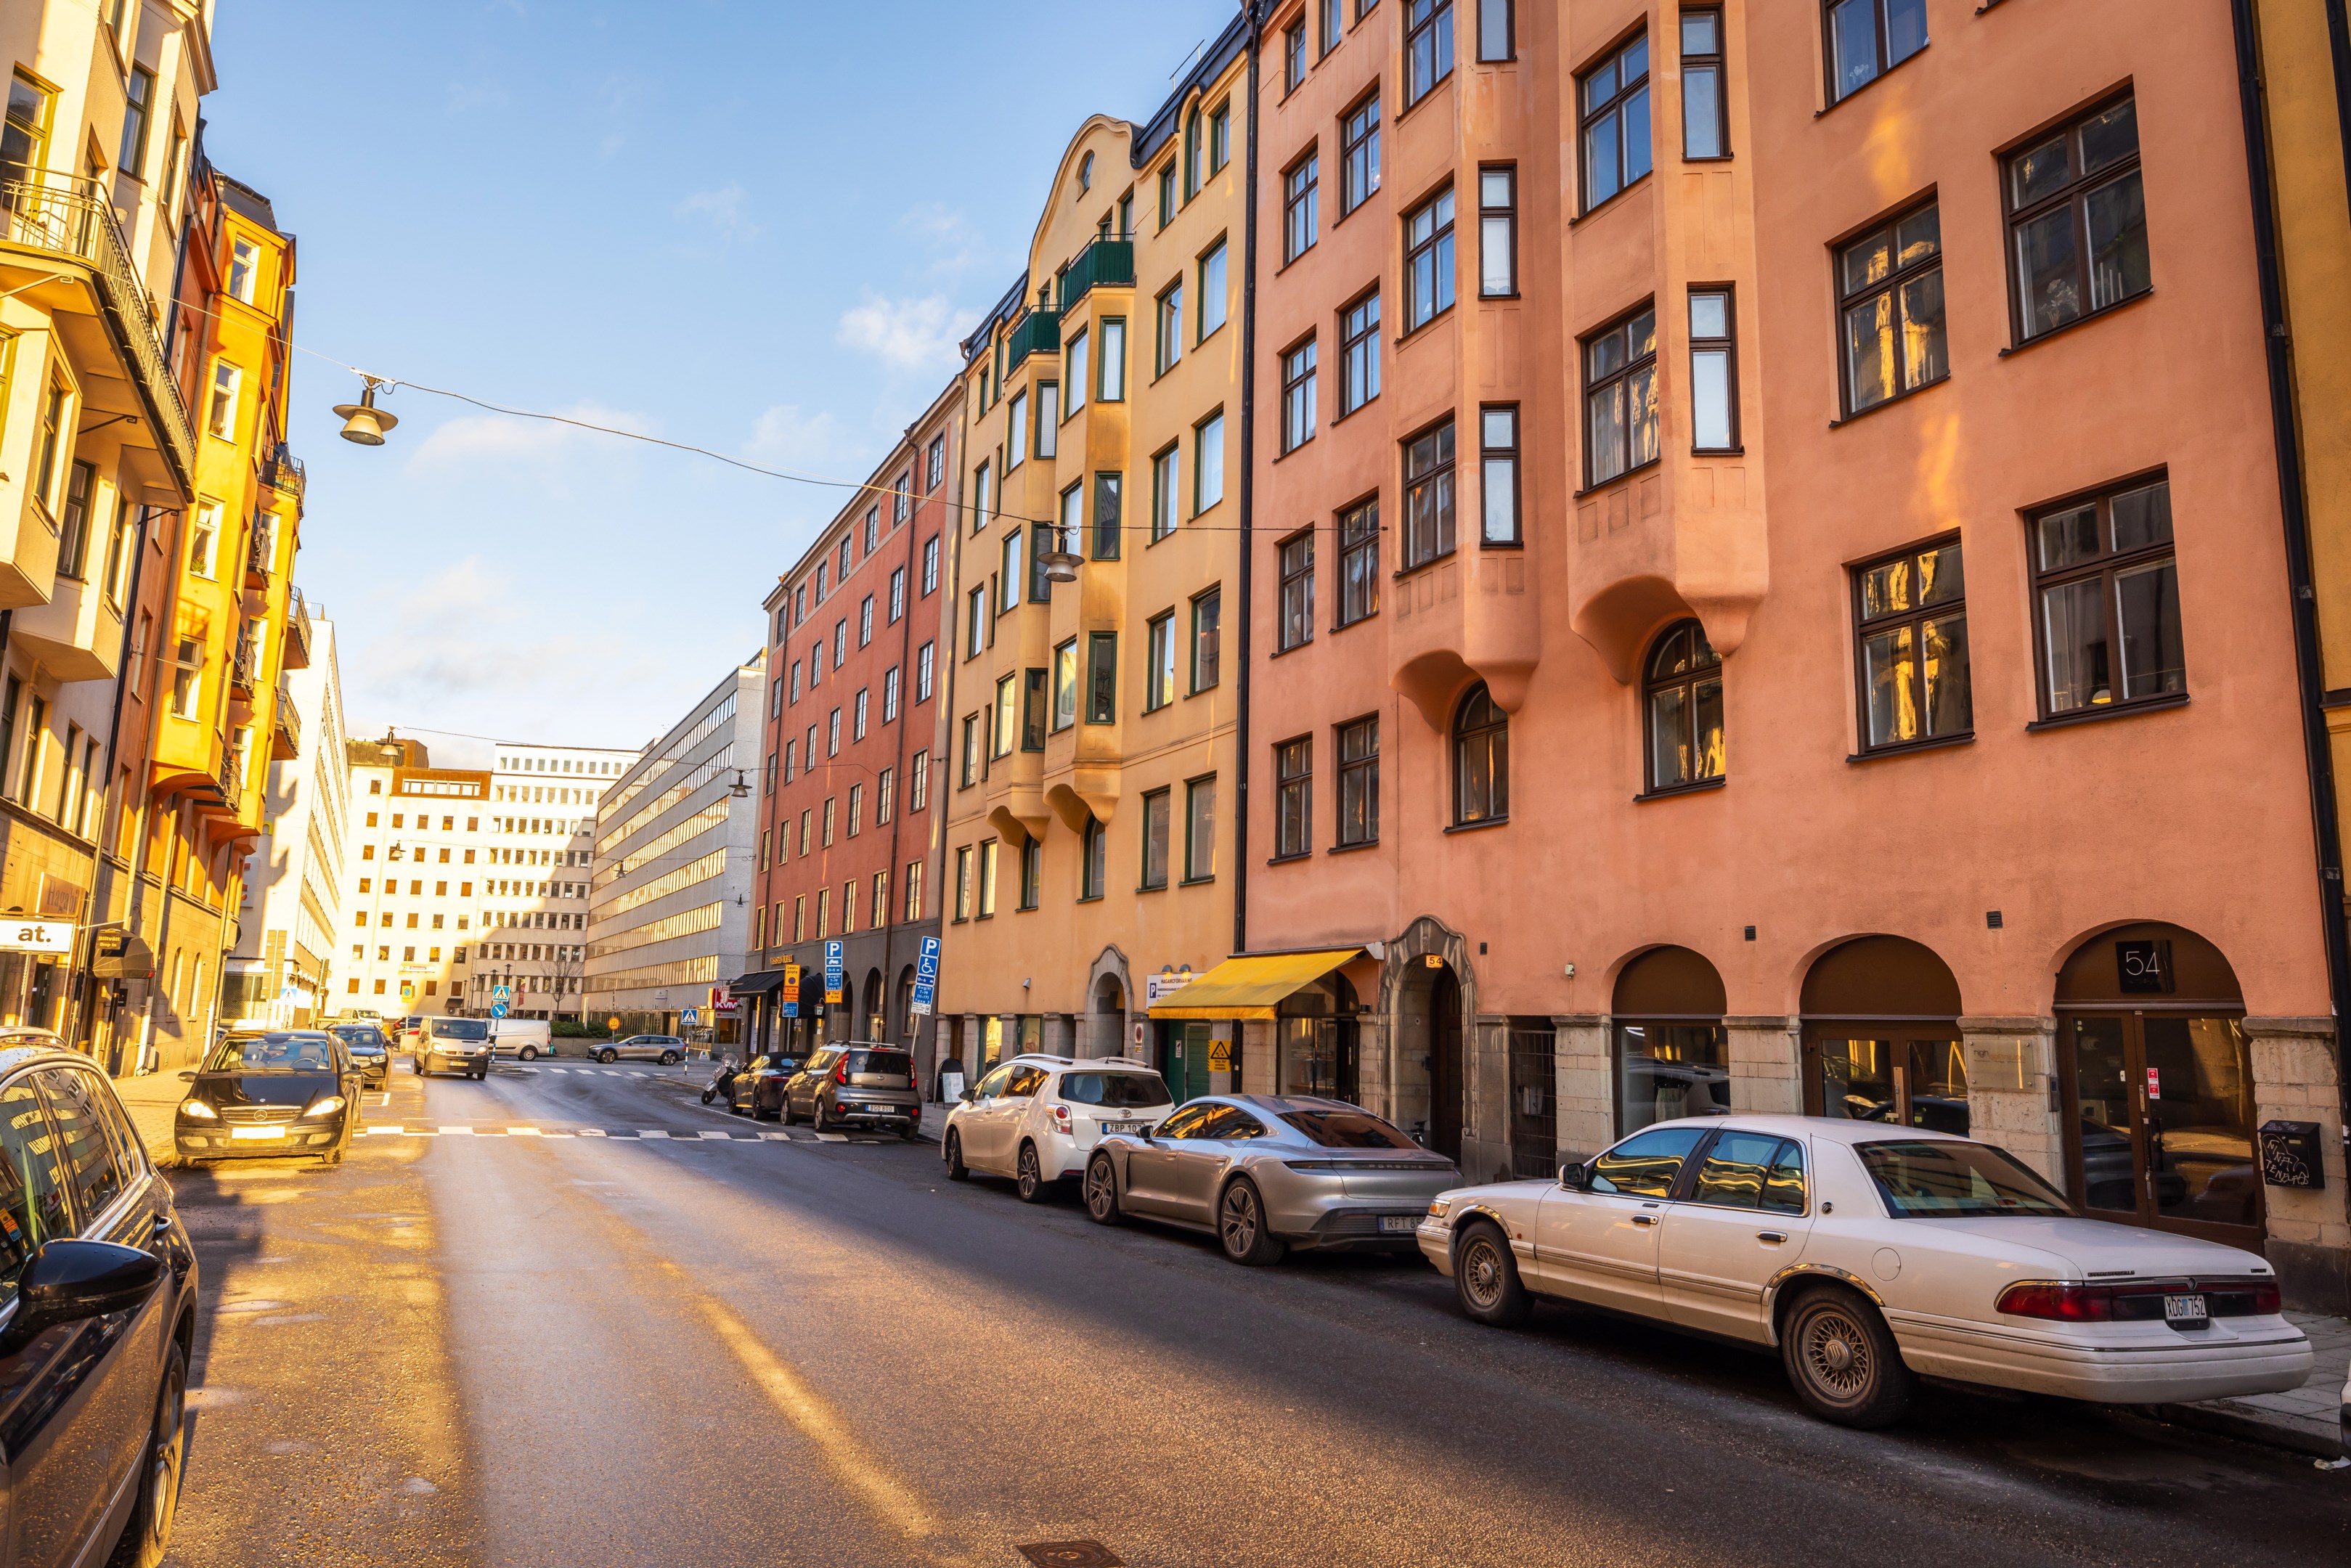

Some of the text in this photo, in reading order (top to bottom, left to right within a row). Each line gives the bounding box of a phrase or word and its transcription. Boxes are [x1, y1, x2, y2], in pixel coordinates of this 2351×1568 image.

[17, 926, 52, 943] at.
[830, 942, 840, 957] P
[925, 939, 937, 954] P
[2126, 951, 2161, 976] 54
[1150, 984, 1156, 997] P
[1109, 1124, 1125, 1132] ZBP
[1388, 1217, 1406, 1228] RFT
[2166, 1298, 2206, 1317] XDG 752
